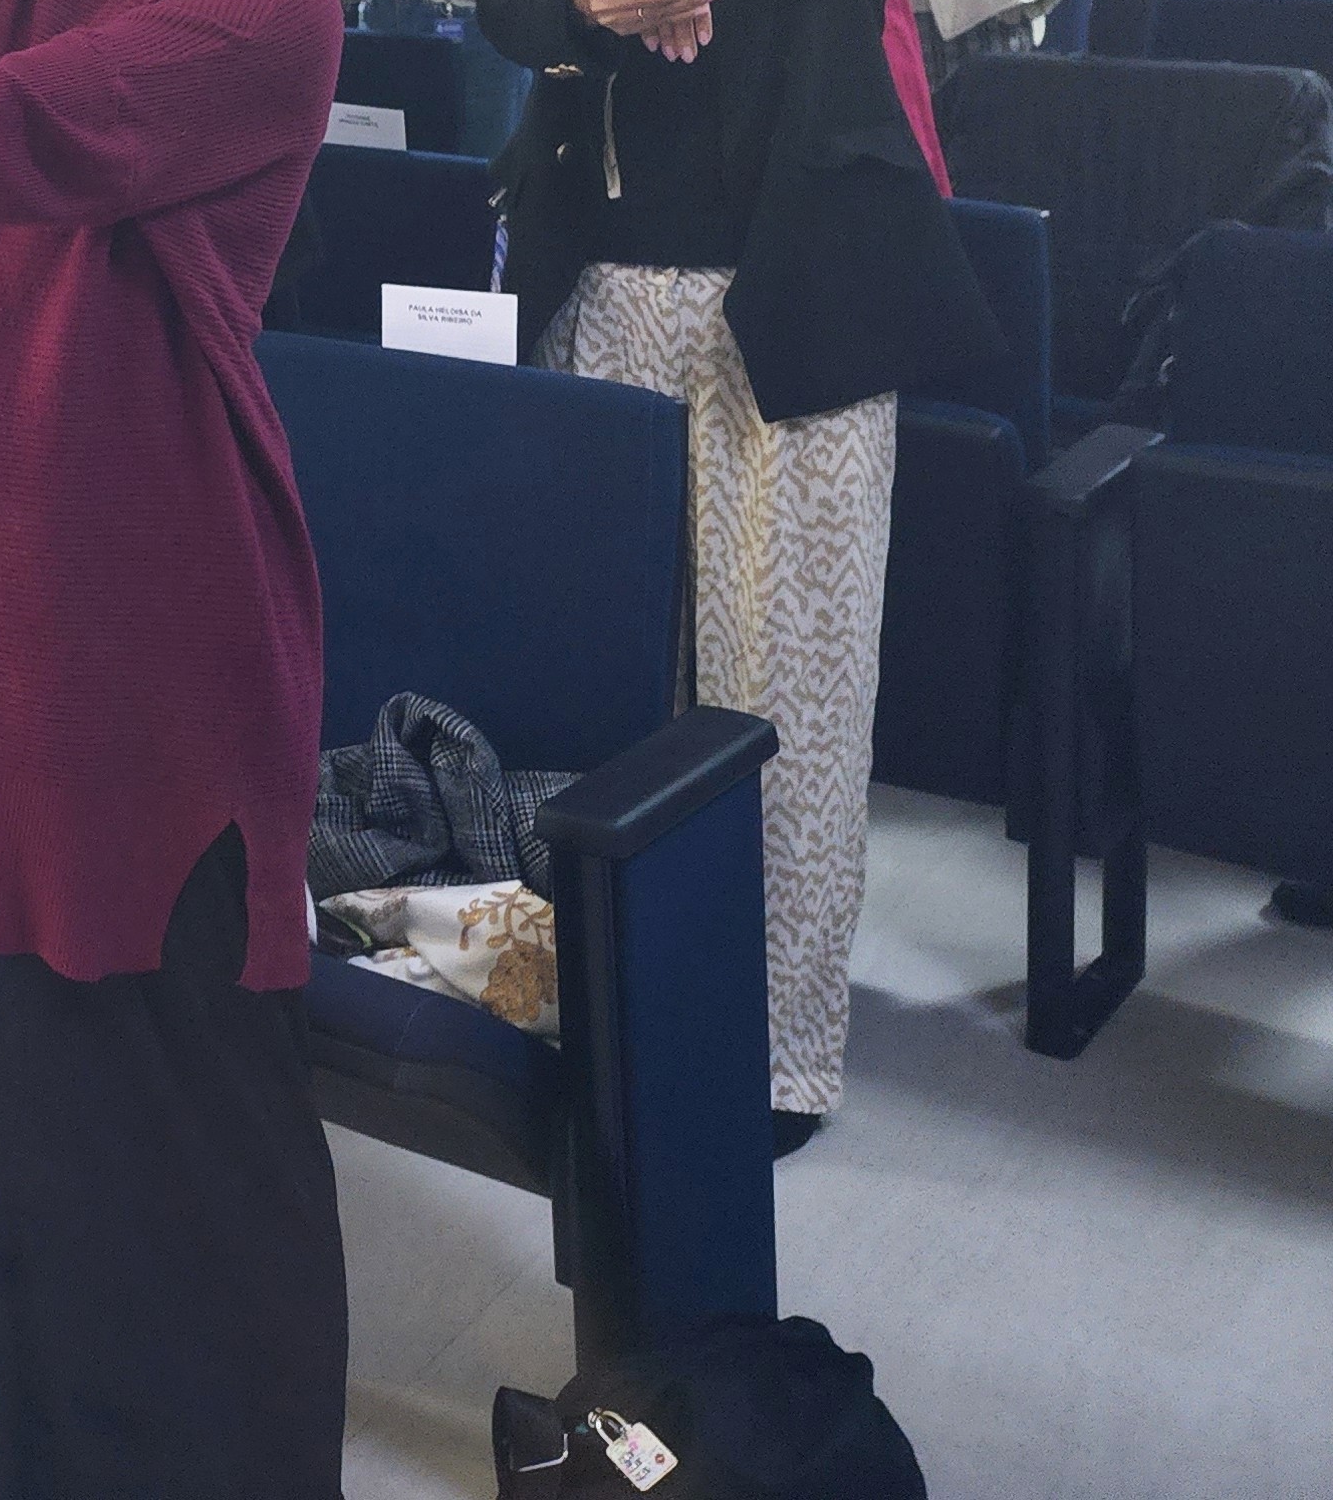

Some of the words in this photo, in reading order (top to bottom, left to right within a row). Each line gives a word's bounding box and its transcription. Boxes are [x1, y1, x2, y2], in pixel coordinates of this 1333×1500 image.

[409, 304, 434, 313] PAULA
[471, 309, 482, 318] DA
[417, 313, 440, 323] SILVA
